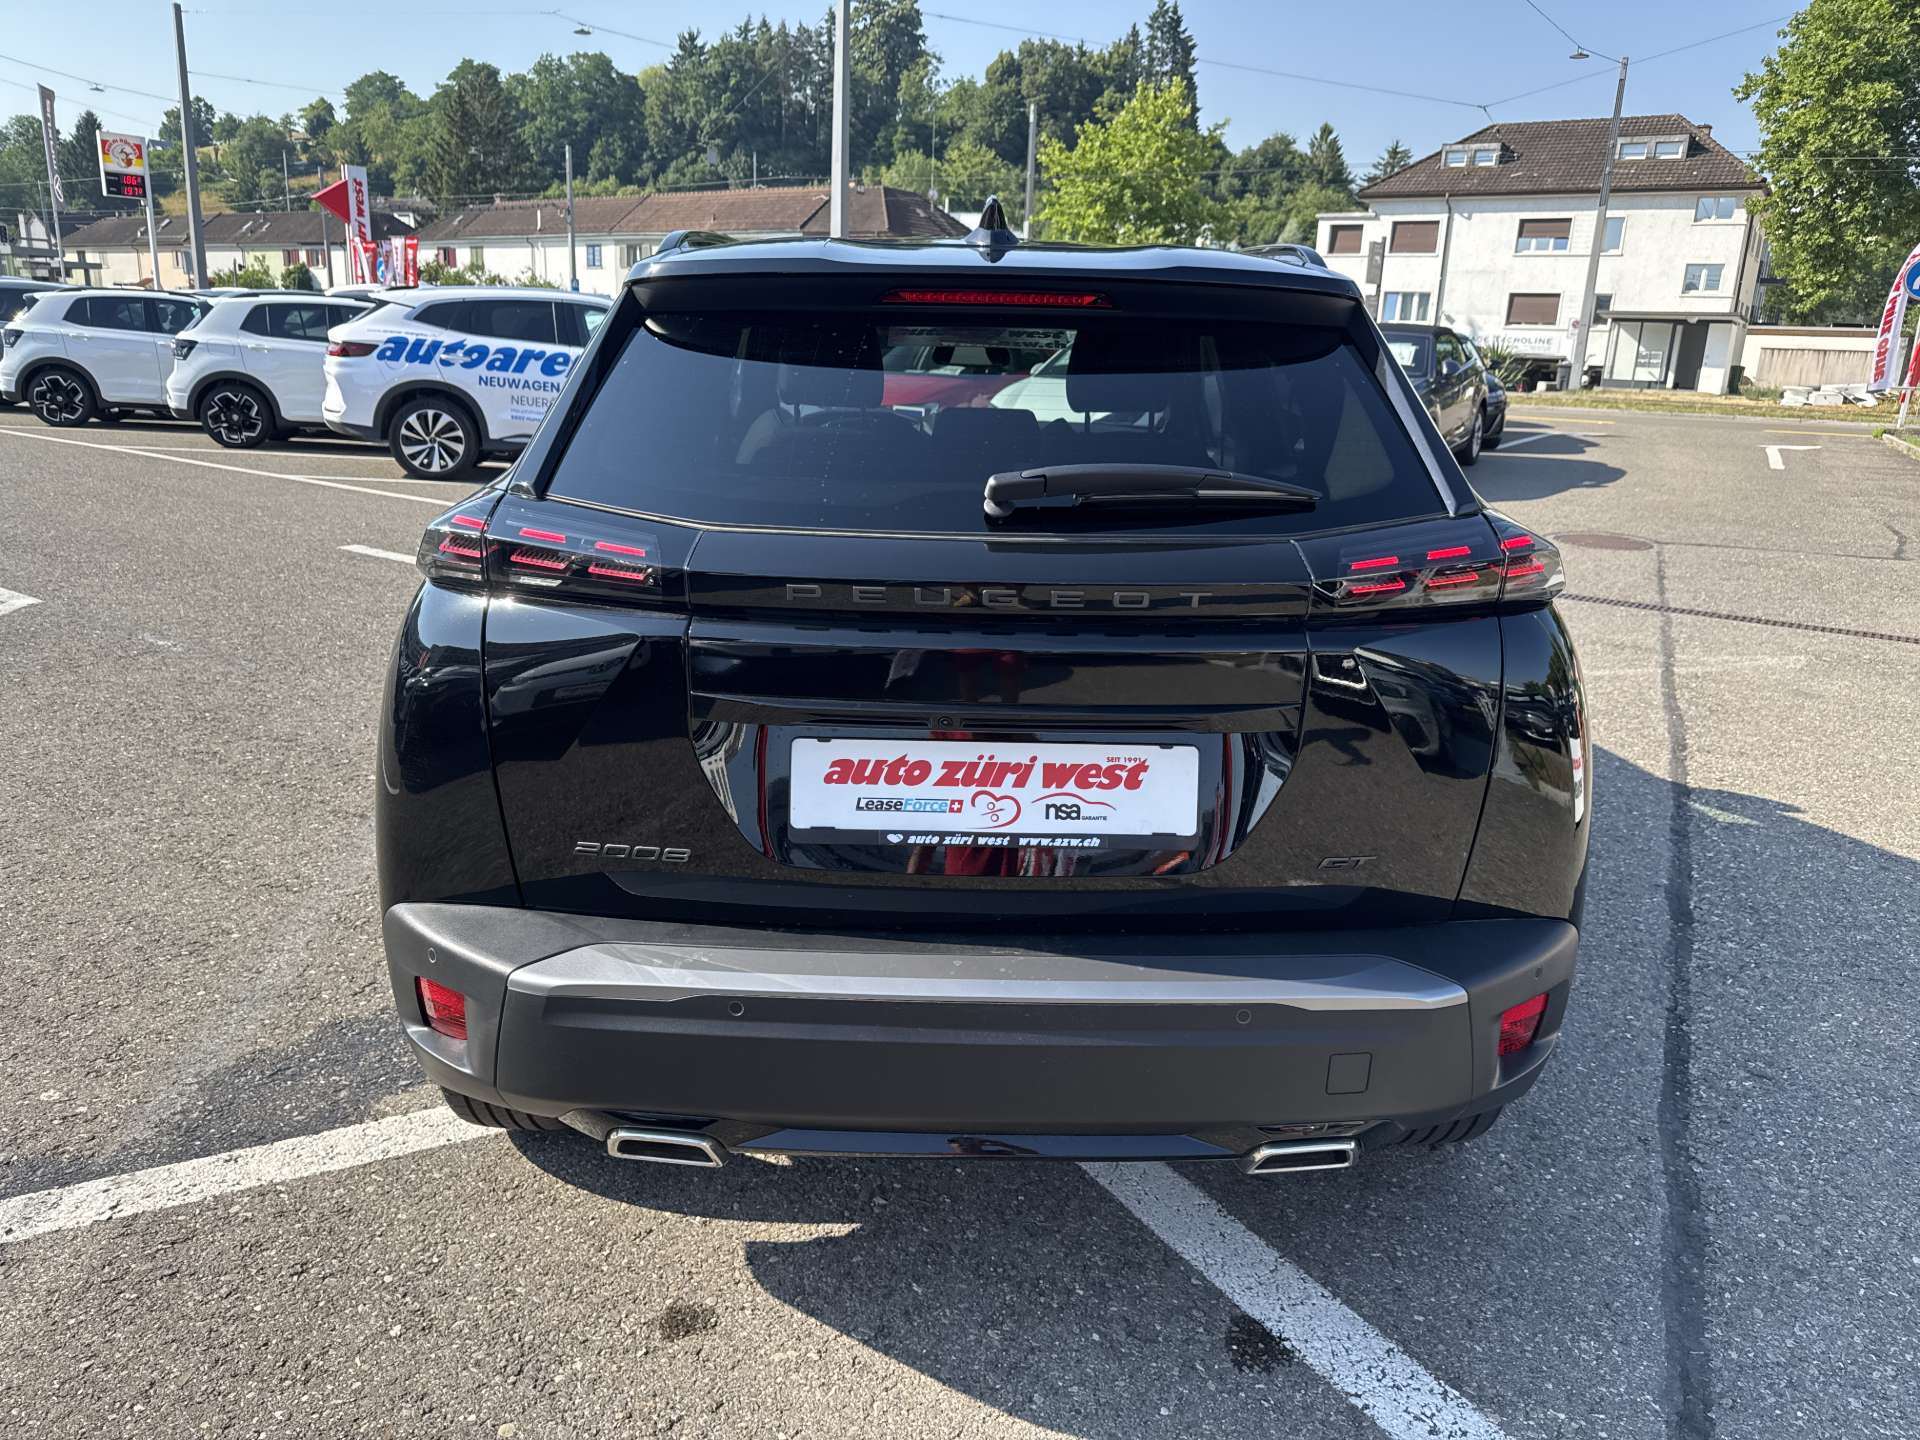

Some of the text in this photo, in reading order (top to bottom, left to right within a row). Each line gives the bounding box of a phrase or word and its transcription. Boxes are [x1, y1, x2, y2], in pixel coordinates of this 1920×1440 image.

[353, 178, 365, 218] west
[376, 336, 578, 378] autoare
[478, 375, 561, 393] NEUWAGEN
[786, 584, 1213, 609] PEUGEOT
[823, 754, 1150, 790] auto züri west
[855, 797, 948, 812] LeaseForce
[1045, 803, 1080, 820] nsa
[907, 834, 1101, 847] auto züri west www.azw.ch
[573, 841, 692, 863] 2008
[1316, 855, 1377, 871] GT
